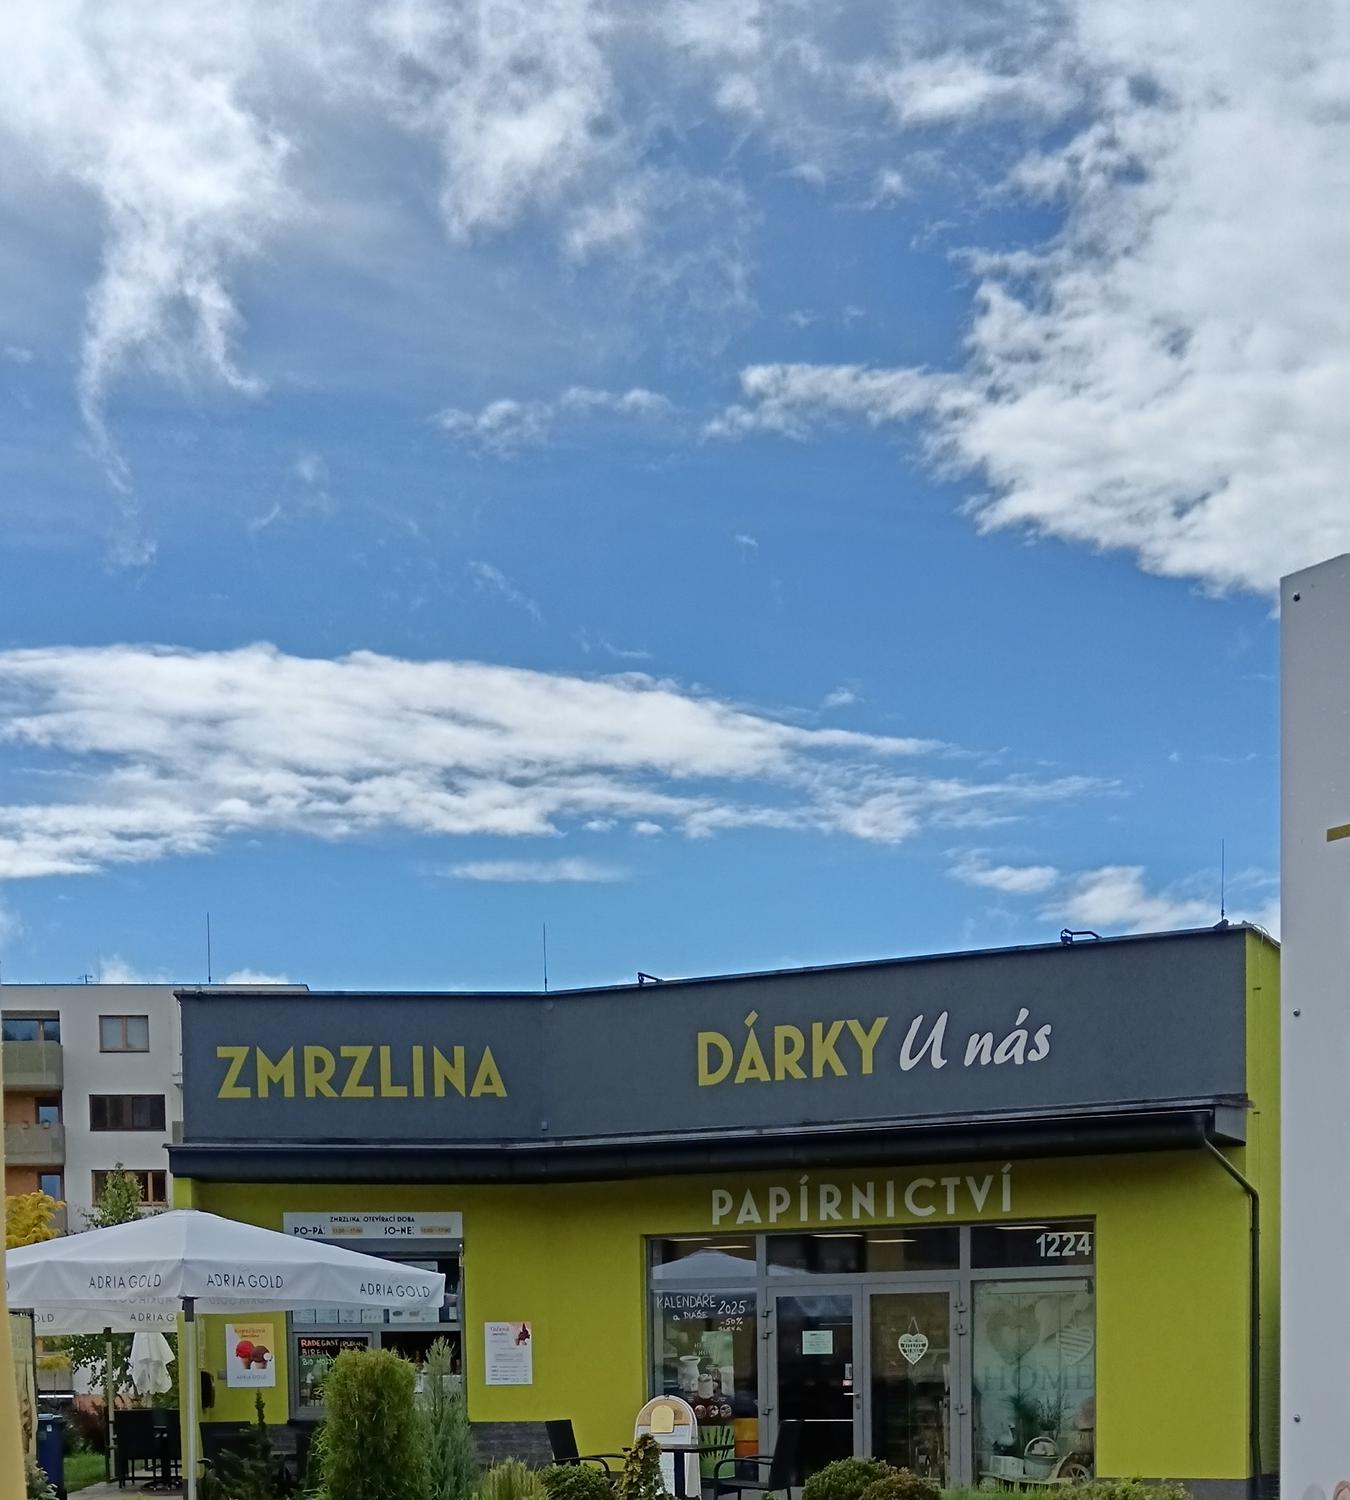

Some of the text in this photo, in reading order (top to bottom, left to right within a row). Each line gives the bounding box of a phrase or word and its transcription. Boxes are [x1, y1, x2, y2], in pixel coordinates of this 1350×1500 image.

[698, 1007, 1051, 1086] DÁRKY U nás
[216, 1045, 508, 1098] ZMRZLINA
[711, 1162, 1012, 1226] PAPÍRNICTVÍ
[1036, 1233, 1091, 1257] 1224
[717, 1300, 747, 1315] 2025
[983, 1365, 1093, 1391] HOME
